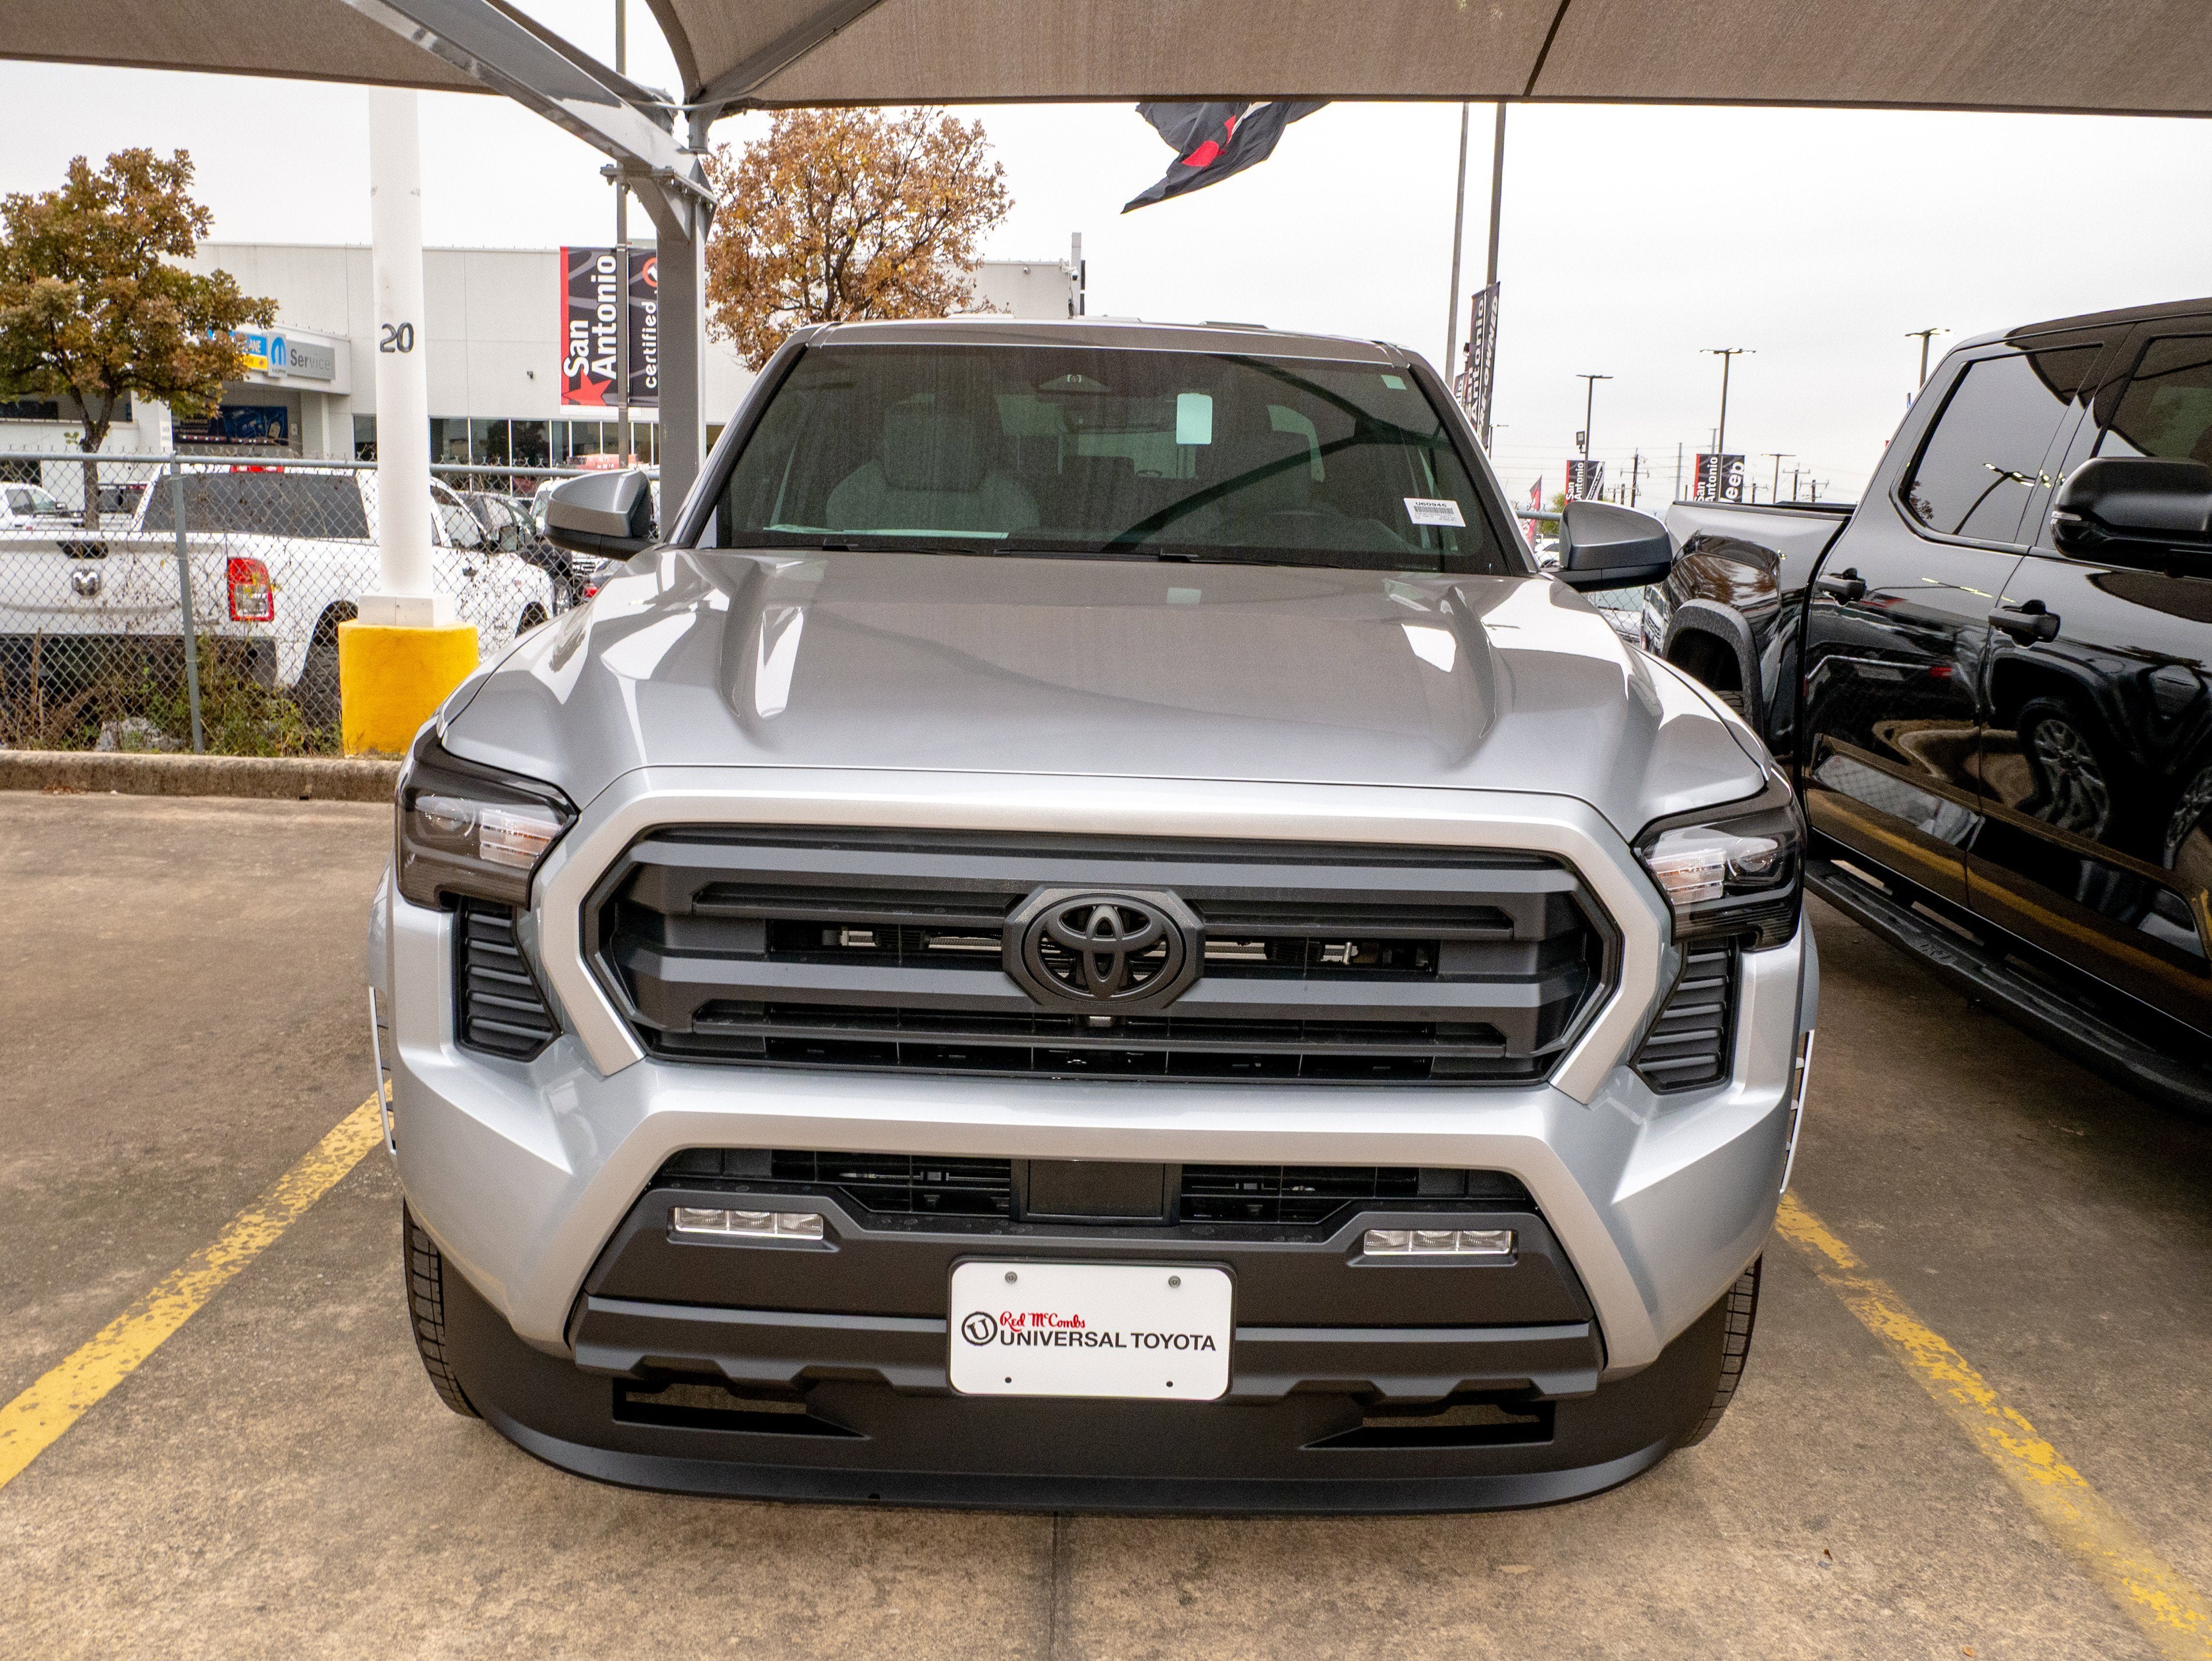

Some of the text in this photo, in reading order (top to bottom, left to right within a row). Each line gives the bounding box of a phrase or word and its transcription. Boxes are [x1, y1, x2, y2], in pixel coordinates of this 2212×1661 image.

[591, 255, 617, 380] Antonio
[380, 322, 414, 353] 20
[563, 320, 589, 378] San
[641, 301, 657, 389] certified
[290, 349, 331, 371] Service
[1471, 298, 1484, 423] Antonio
[1478, 295, 1498, 442] PRE-OWNED
[1566, 481, 1574, 500] San
[1574, 462, 1584, 500] Antonio
[1694, 482, 1706, 502] San
[1705, 457, 1718, 502] Antonio
[1000, 1311, 1086, 1332] Red McCombs
[1001, 1330, 1217, 1351] UNIVERSAL TOYOTA
